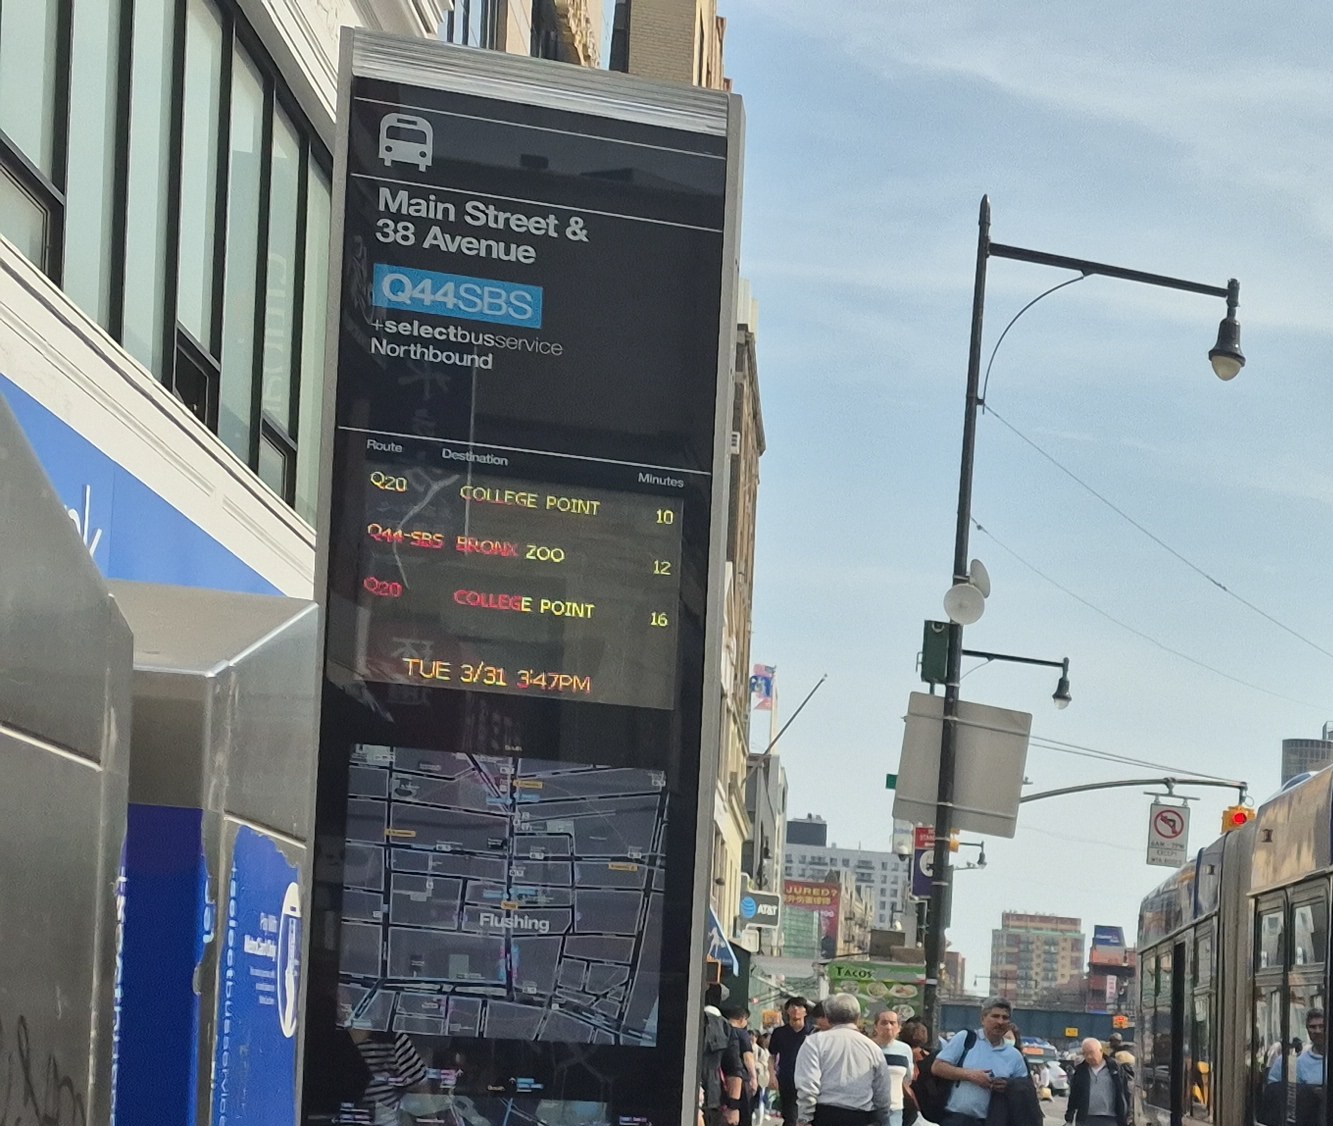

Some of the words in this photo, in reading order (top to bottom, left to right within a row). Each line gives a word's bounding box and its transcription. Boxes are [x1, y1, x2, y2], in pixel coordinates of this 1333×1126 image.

[378, 187, 455, 222] Main
[464, 199, 559, 238] Street
[566, 216, 590, 242] &
[376, 218, 416, 246] 38
[422, 225, 536, 264] Avenue
[381, 273, 534, 320] Q44SBS
[370, 338, 492, 370] Northbound
[367, 439, 402, 453] Route
[442, 448, 508, 466] Destination
[638, 472, 684, 488] Minutes
[370, 471, 408, 492] Q20
[460, 485, 538, 509] COLLEGE
[546, 496, 600, 516] POINT
[656, 509, 674, 526] 10
[367, 523, 444, 550] Q44-SBS
[455, 536, 518, 557] BRONX
[526, 544, 565, 562] ZOO
[654, 560, 671, 576] 12
[363, 577, 402, 598] Q20
[454, 590, 532, 612] COLLEGE
[540, 600, 596, 619] POINT
[650, 612, 668, 628] 16
[402, 657, 451, 682] TUE
[460, 660, 508, 687] 3/31
[516, 669, 592, 694] 3:47PM
[479, 912, 550, 932] Flushing
[757, 904, 777, 916] AT&T
